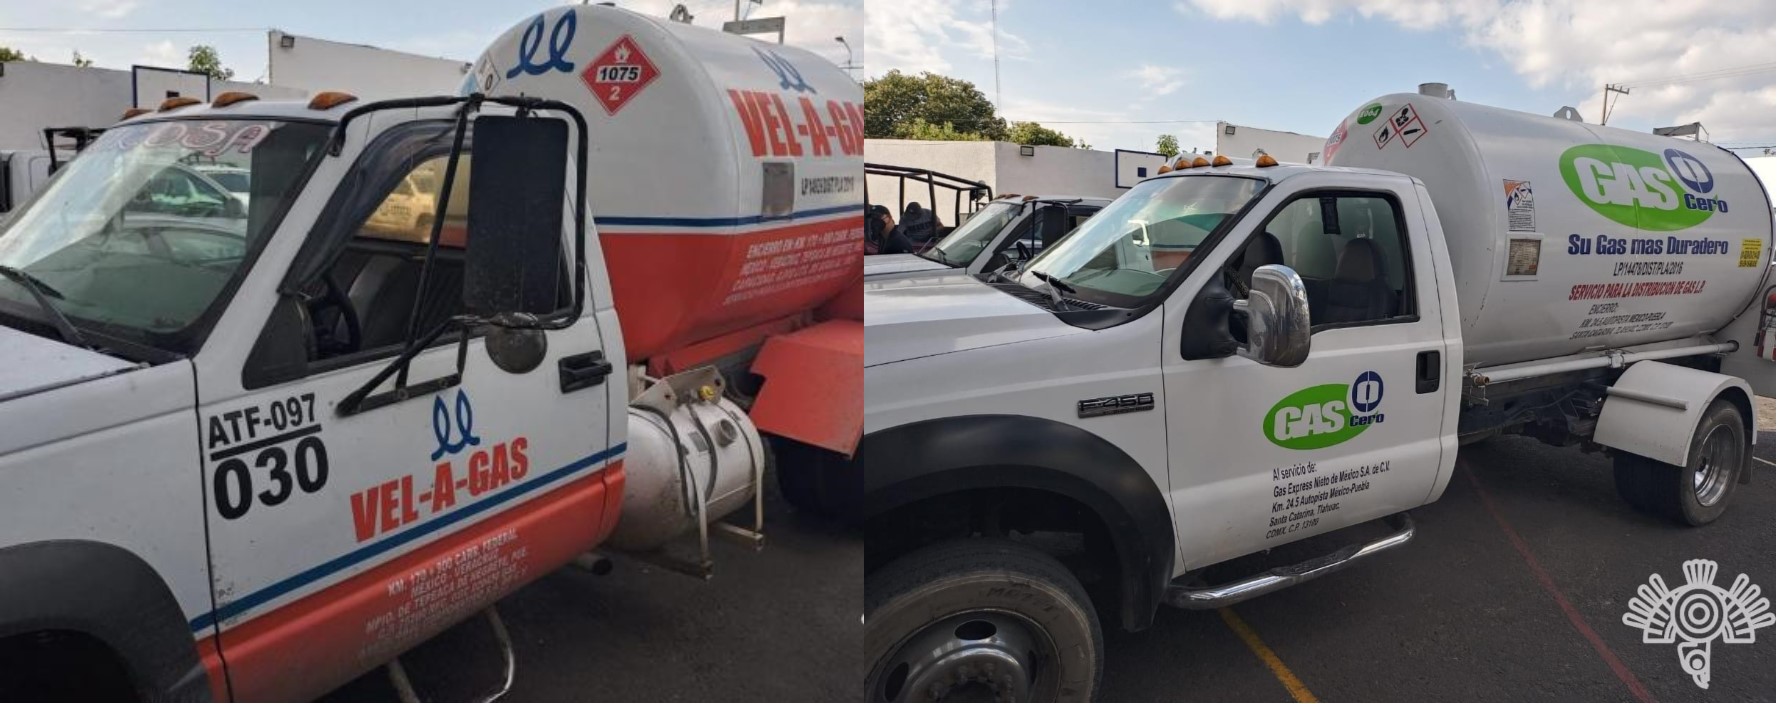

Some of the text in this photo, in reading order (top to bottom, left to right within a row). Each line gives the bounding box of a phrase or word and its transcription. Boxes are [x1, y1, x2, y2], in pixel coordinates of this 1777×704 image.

[599, 66, 640, 81] 1075
[609, 86, 621, 100] 2
[727, 89, 864, 157] VEL-A-GA
[1573, 157, 1680, 211] GAS
[1683, 193, 1728, 213] Cero
[1568, 234, 1591, 255] Su
[1595, 234, 1626, 255] Gas
[1630, 238, 1663, 255] mas
[1666, 236, 1728, 255] Duradero
[1568, 284, 1605, 300] SERVICIO
[1603, 282, 1621, 298] PARA
[1621, 282, 1634, 297] LA
[209, 393, 315, 449] ATF-097
[1274, 401, 1345, 440] GAS
[1350, 413, 1384, 427] Cero
[214, 436, 329, 520] 030
[1273, 468, 1280, 481] Al
[1281, 464, 1305, 479] servicio
[1274, 485, 1287, 497] Gas
[1288, 480, 1312, 495] Express
[1314, 476, 1330, 488] Nieto
[1331, 473, 1338, 484] de
[1372, 464, 1379, 474] de
[350, 437, 528, 543] VEL-A-GAS
[1272, 502, 1285, 513] Km.
[1300, 491, 1328, 506] Autopista
[1269, 514, 1287, 527] Santa
